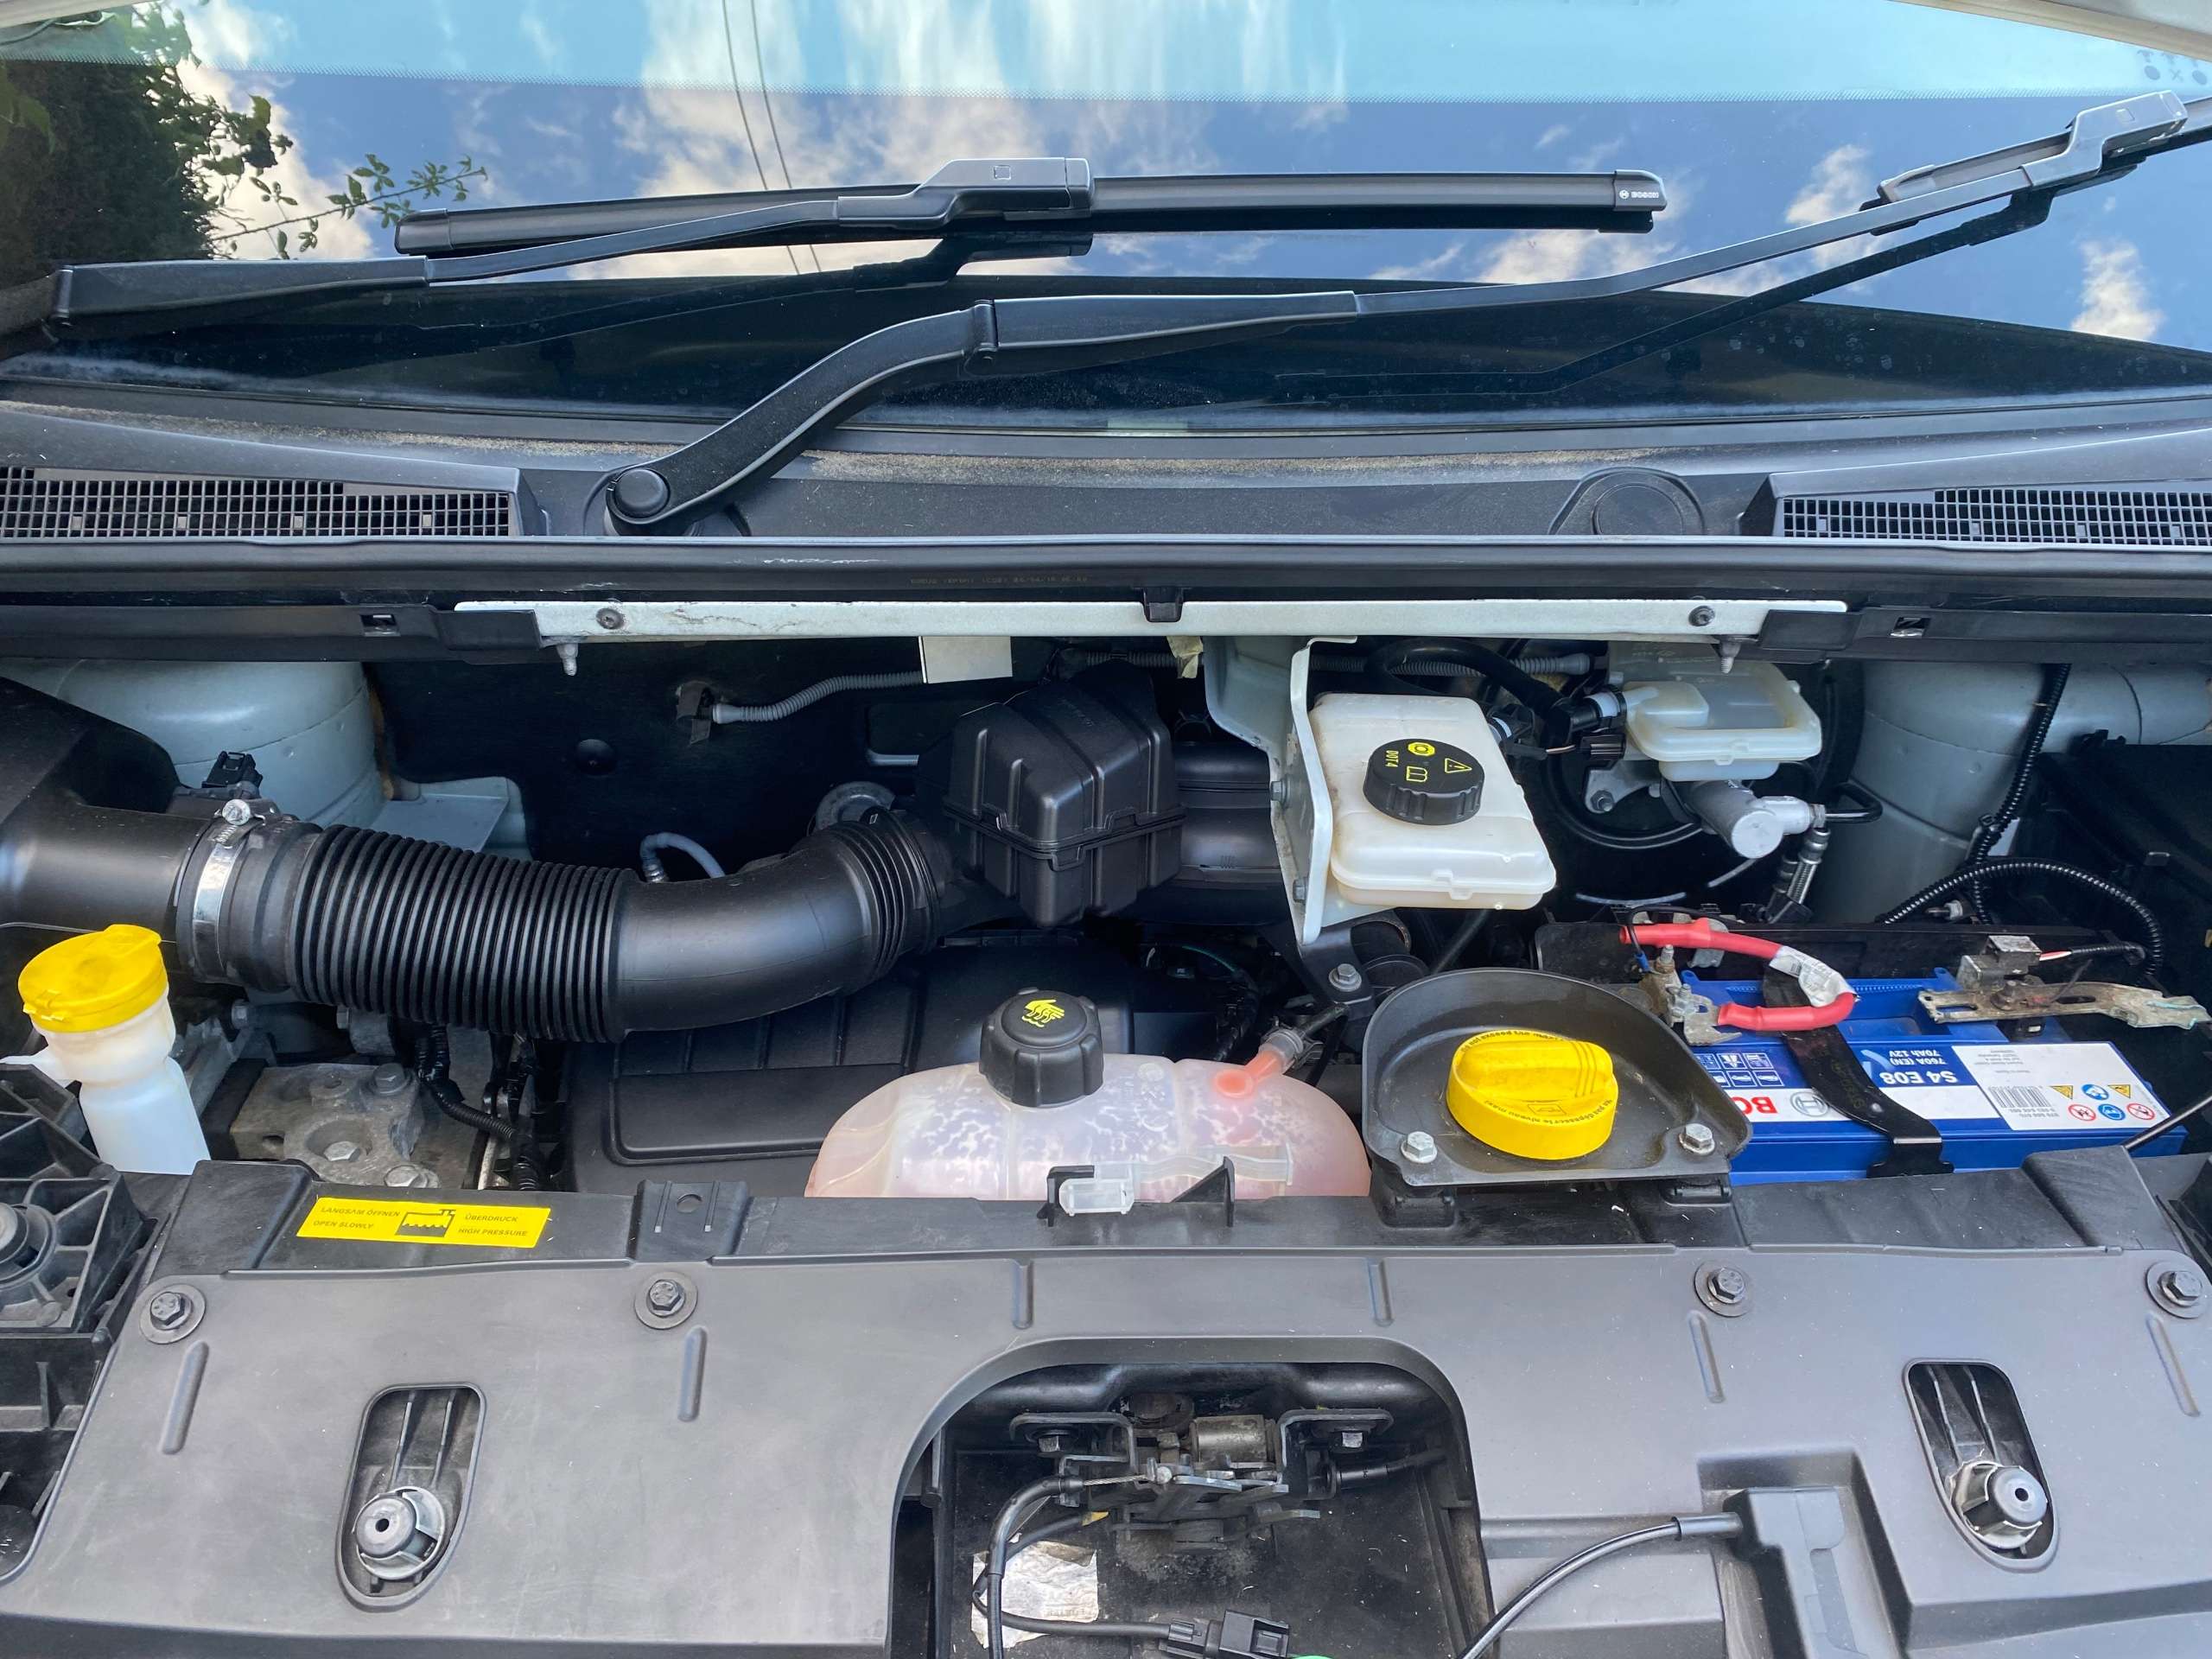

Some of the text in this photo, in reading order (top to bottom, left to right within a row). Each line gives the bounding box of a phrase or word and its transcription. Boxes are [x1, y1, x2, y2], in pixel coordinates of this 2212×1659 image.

[1889, 1057, 1915, 1065] (EN)
[1878, 1071, 1958, 1084] S4 E08
[321, 1207, 401, 1217] LANGSAM ÖFFNEN
[465, 1212, 518, 1222] ÜBERDRUCK
[482, 1228, 528, 1236] PRESSURE
